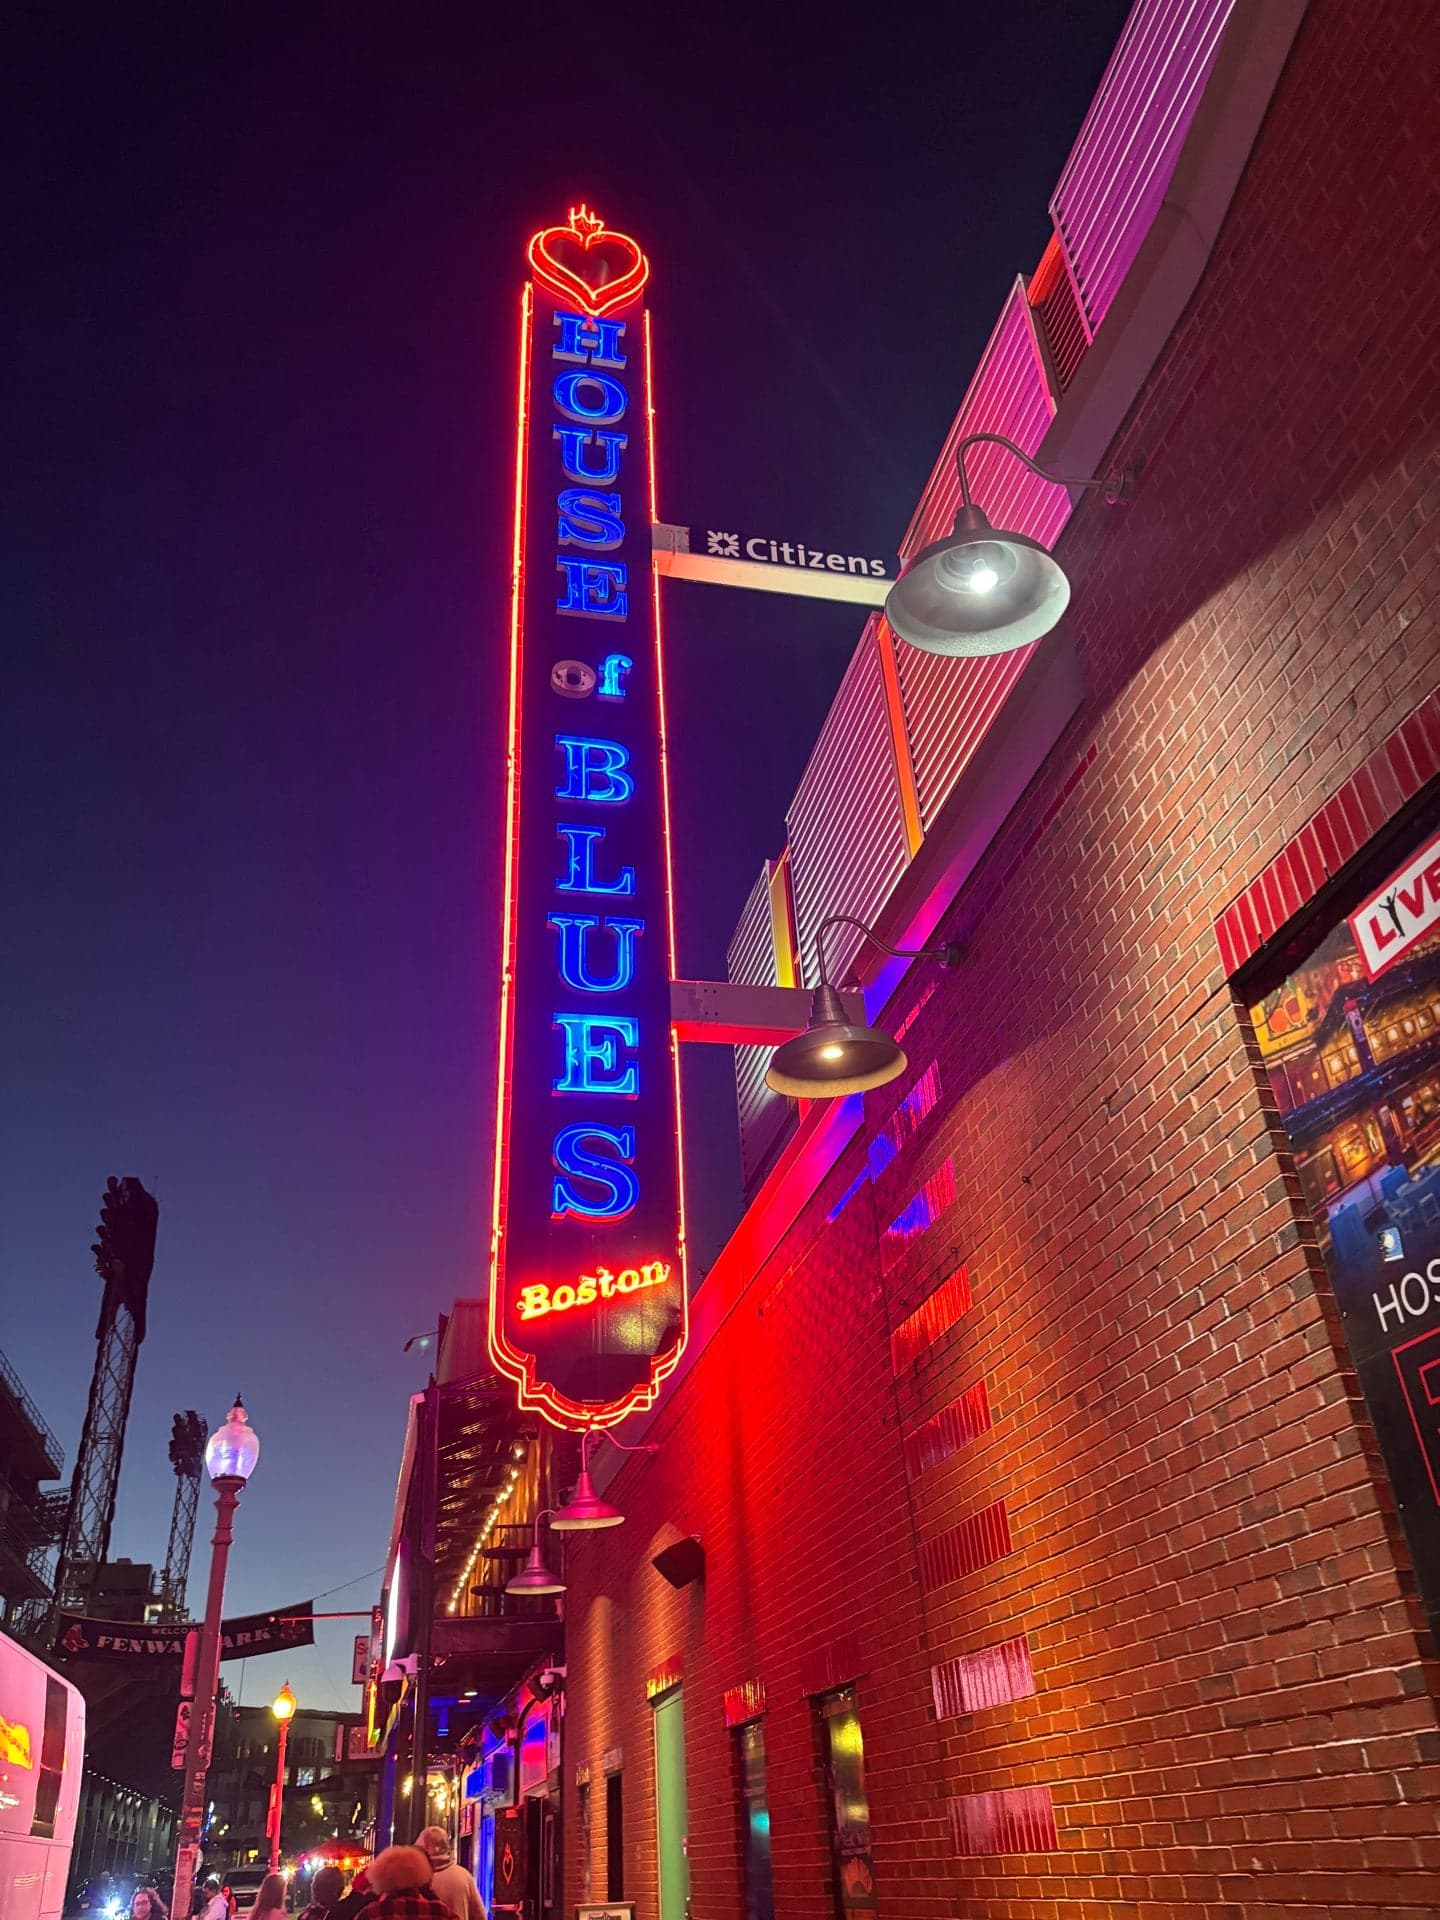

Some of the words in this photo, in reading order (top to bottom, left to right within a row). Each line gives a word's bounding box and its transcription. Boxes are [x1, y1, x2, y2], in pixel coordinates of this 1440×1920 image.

[552, 311, 628, 621] HOUSE
[746, 538, 887, 577] Citizens
[551, 654, 632, 703] of
[547, 734, 644, 1221] BLUES
[516, 1261, 671, 1321] Boston
[97, 1635, 187, 1654] FENWA
[221, 1627, 272, 1649] ARK
